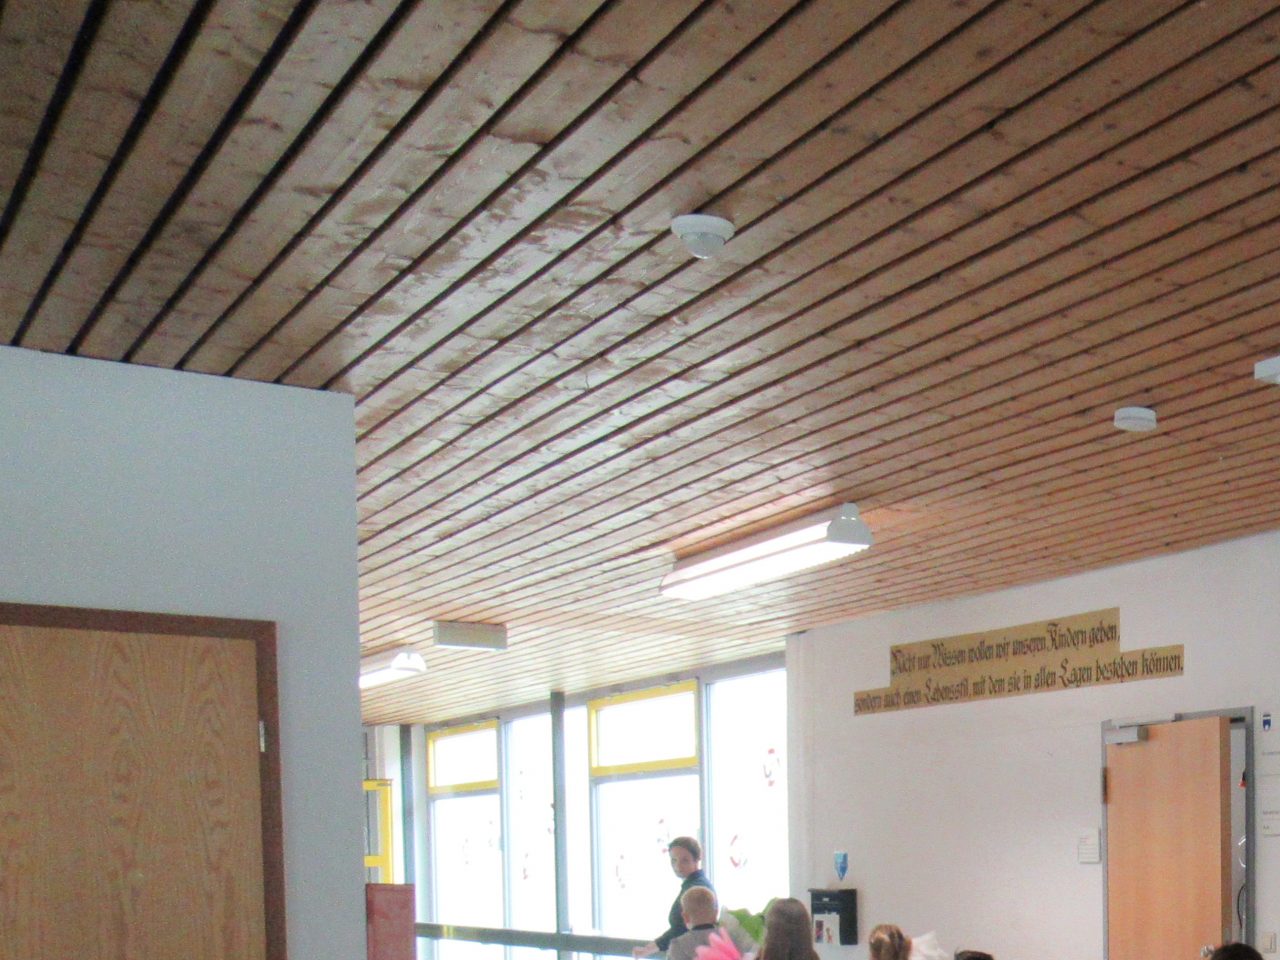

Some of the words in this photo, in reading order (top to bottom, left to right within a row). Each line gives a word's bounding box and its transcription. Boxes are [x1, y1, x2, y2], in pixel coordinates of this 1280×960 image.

[931, 641, 966, 668] Wissen
[968, 640, 993, 663] wollen
[995, 637, 1010, 662] wir
[1012, 637, 1046, 657] unseren
[1047, 622, 1087, 650] Kindern
[883, 688, 899, 707] auch
[903, 689, 922, 705] einen
[988, 674, 1005, 695] dem
[1008, 671, 1020, 693] sie
[1023, 669, 1032, 690] in
[1034, 665, 1057, 689] allen
[1059, 657, 1092, 688] Lagen
[1095, 655, 1138, 683] bestehen
[1141, 651, 1184, 676] können.
